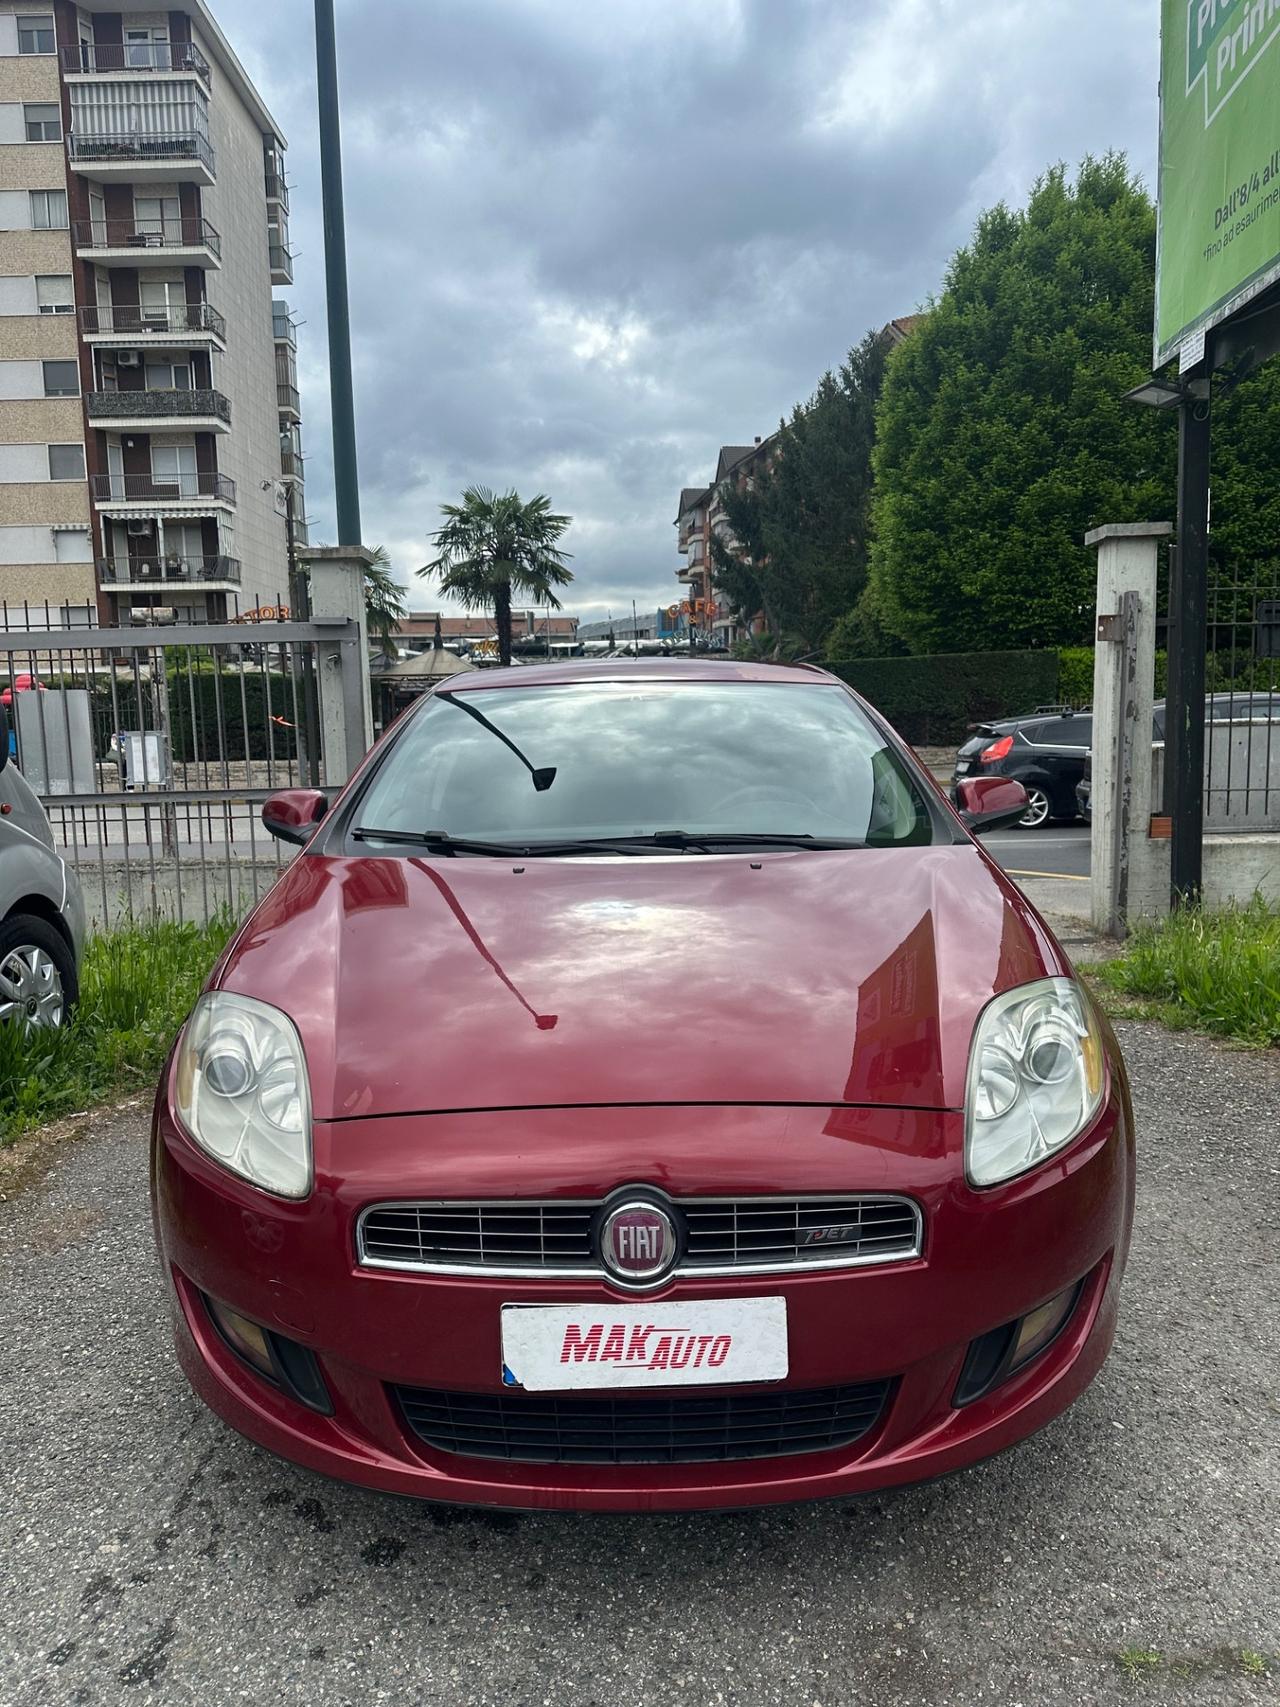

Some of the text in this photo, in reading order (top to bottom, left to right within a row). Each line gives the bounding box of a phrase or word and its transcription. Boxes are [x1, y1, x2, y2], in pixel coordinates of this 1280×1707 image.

[1214, 171, 1260, 231] Dall'8/4
[1235, 186, 1280, 236] esaurime
[618, 1226, 660, 1259] FIAT
[560, 1324, 732, 1370] MAK AUTO
